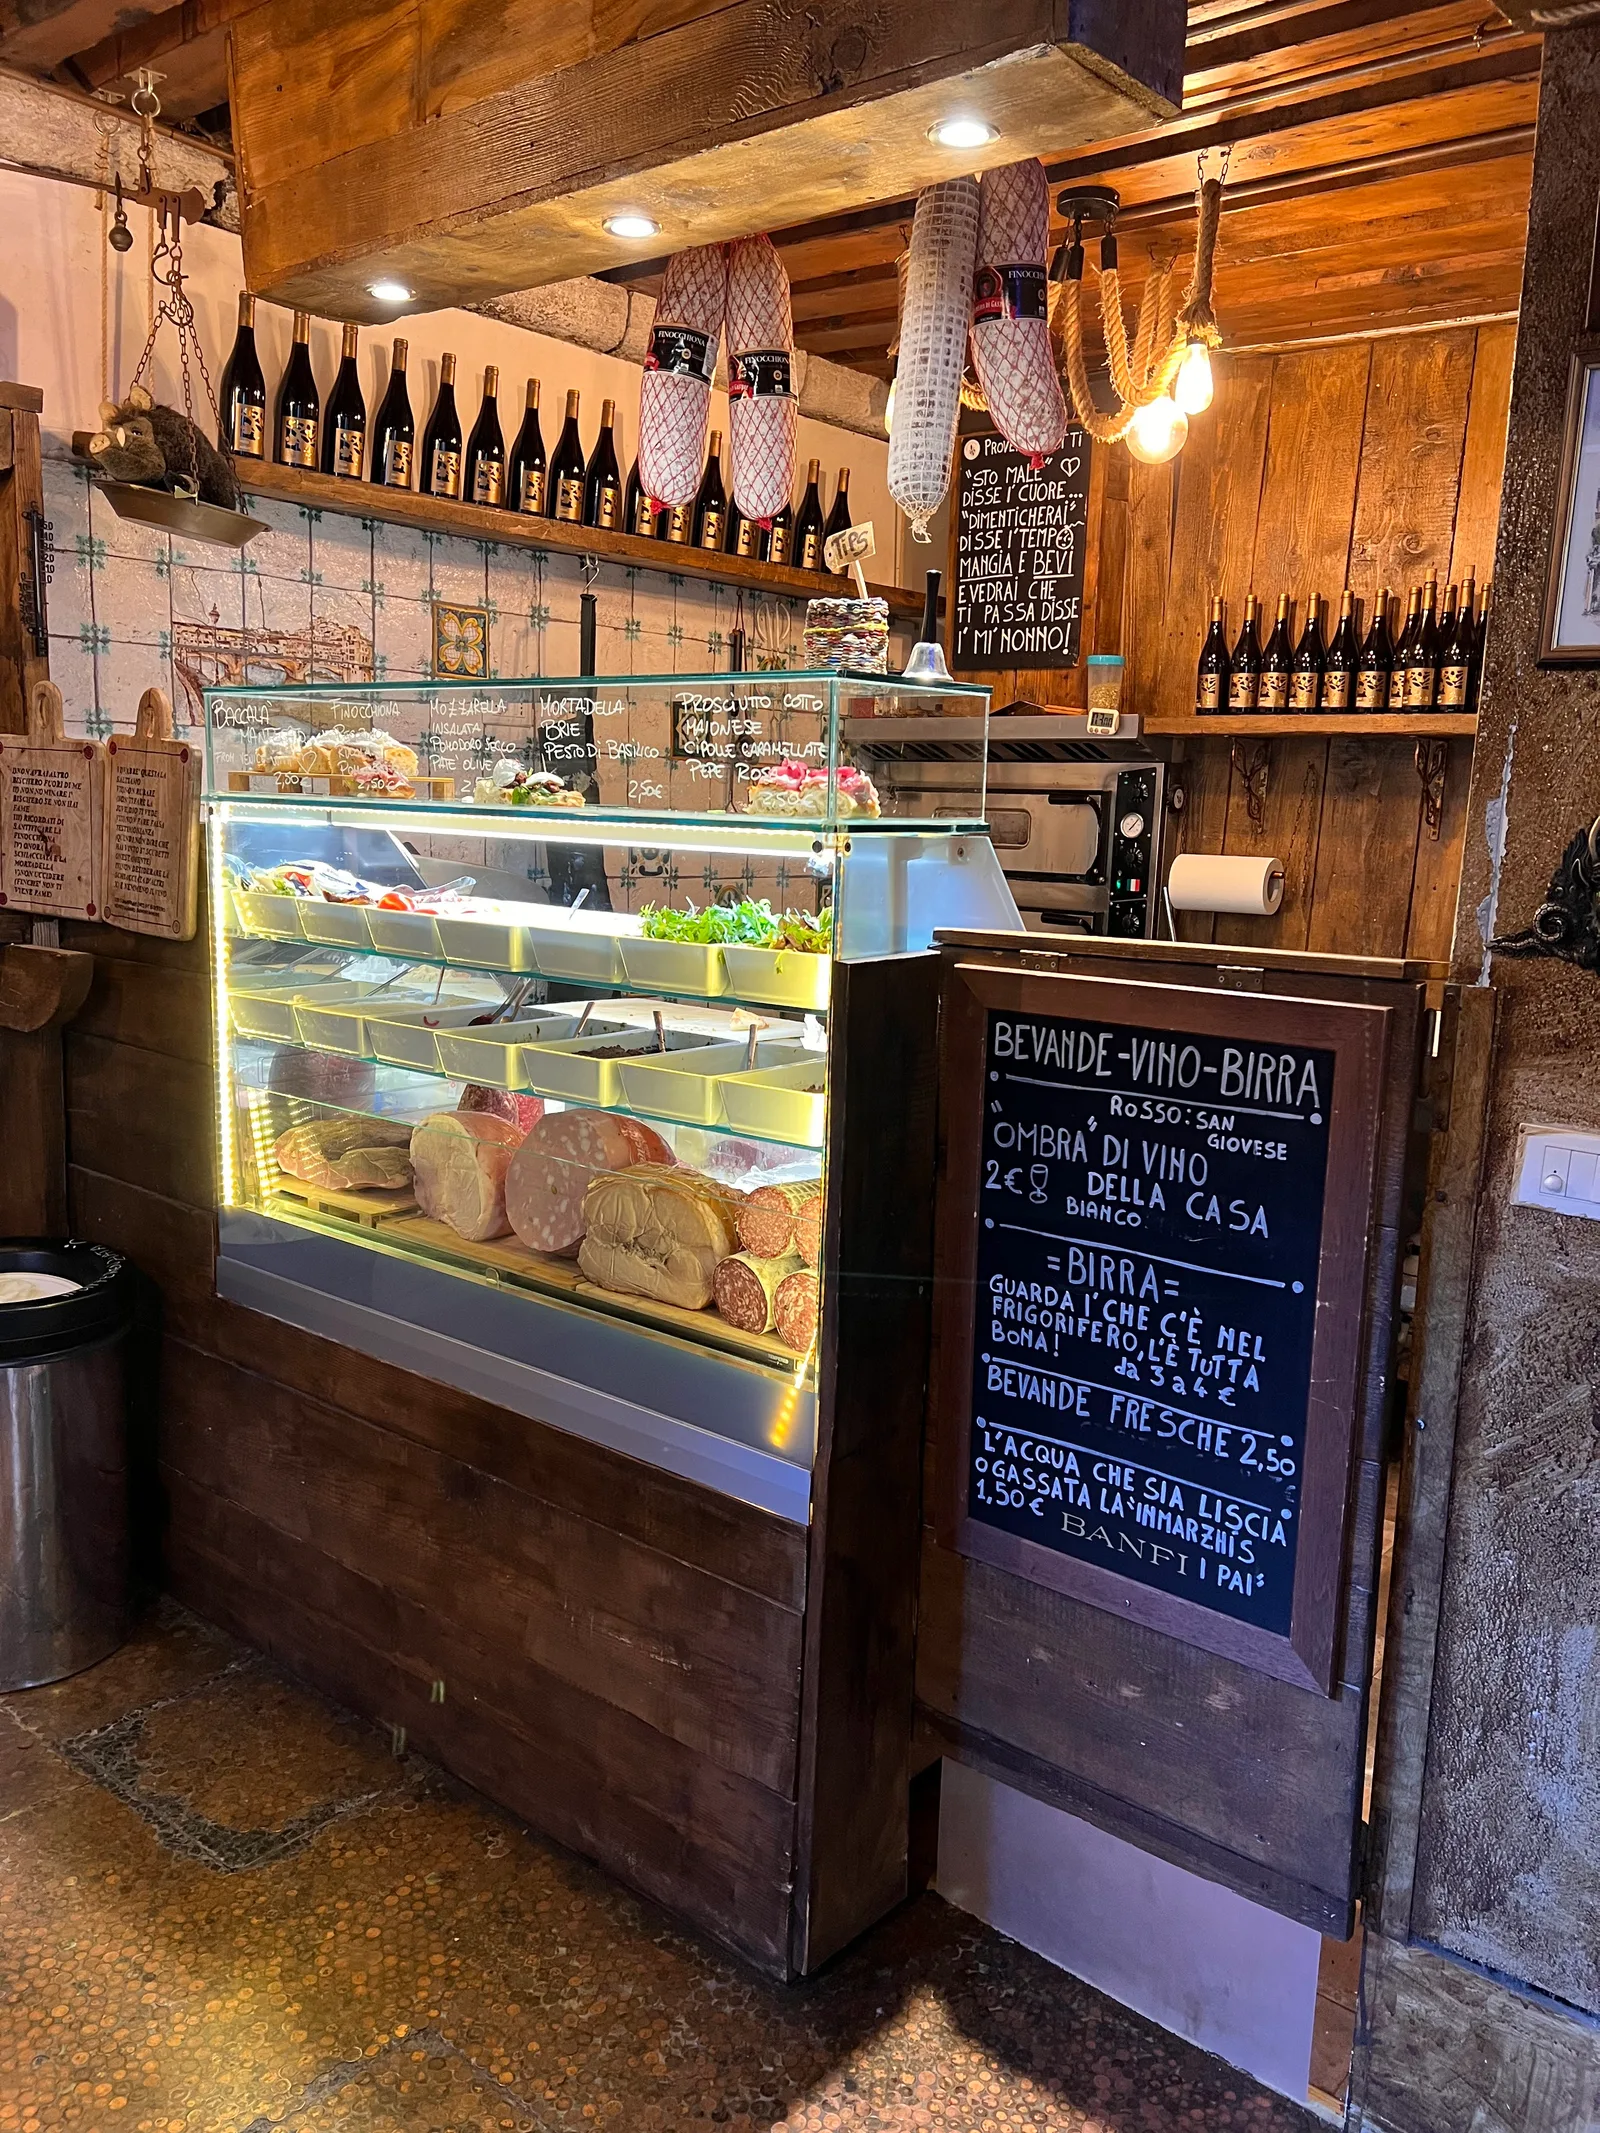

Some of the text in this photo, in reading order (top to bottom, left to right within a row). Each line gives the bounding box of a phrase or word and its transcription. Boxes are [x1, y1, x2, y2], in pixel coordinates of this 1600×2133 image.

[1018, 551, 1028, 574] E
[958, 584, 967, 604] E
[1027, 580, 1057, 601] CHE
[984, 601, 1035, 624] PASSA
[1000, 622, 1072, 655] NONNO!
[429, 697, 507, 718] MOZZARELLA
[539, 693, 625, 717] MORTADELLA
[783, 693, 824, 712] COTTO
[432, 722, 482, 736] INSALATA
[540, 719, 581, 741] BRIE
[685, 719, 763, 736] MAIONESE
[429, 735, 516, 753] POMODORO SECCO
[543, 741, 585, 761] PESTO
[462, 758, 493, 771] OLIVE
[685, 758, 726, 782] PEPE
[1195, 1111, 1235, 1131] SAN
[1207, 1133, 1288, 1161] GIOVESE
[1102, 1134, 1130, 1169] DI
[1142, 1140, 1209, 1186] VINO
[1066, 1196, 1142, 1227] BIANCO
[1087, 1171, 1166, 1211] DELLA
[1185, 1191, 1270, 1238] CASA
[989, 1274, 1075, 1312] GUARDA
[1102, 1299, 1151, 1330] CHE
[1216, 1324, 1266, 1362] NEL
[1150, 1365, 1165, 1386] 3
[1193, 1377, 1208, 1398] 4
[1187, 1347, 1260, 1392] TUTTA
[987, 1364, 1092, 1417] BEVANDE
[1109, 1393, 1232, 1458] FRESCHE
[984, 1431, 1287, 1547] L'ACQUA CHE SIA LISCIA
[991, 1460, 1091, 1510] GASSATA
[1099, 1488, 1125, 1518] LA
[1061, 1511, 1189, 1576] BANFI
[1199, 1557, 1206, 1580] I
